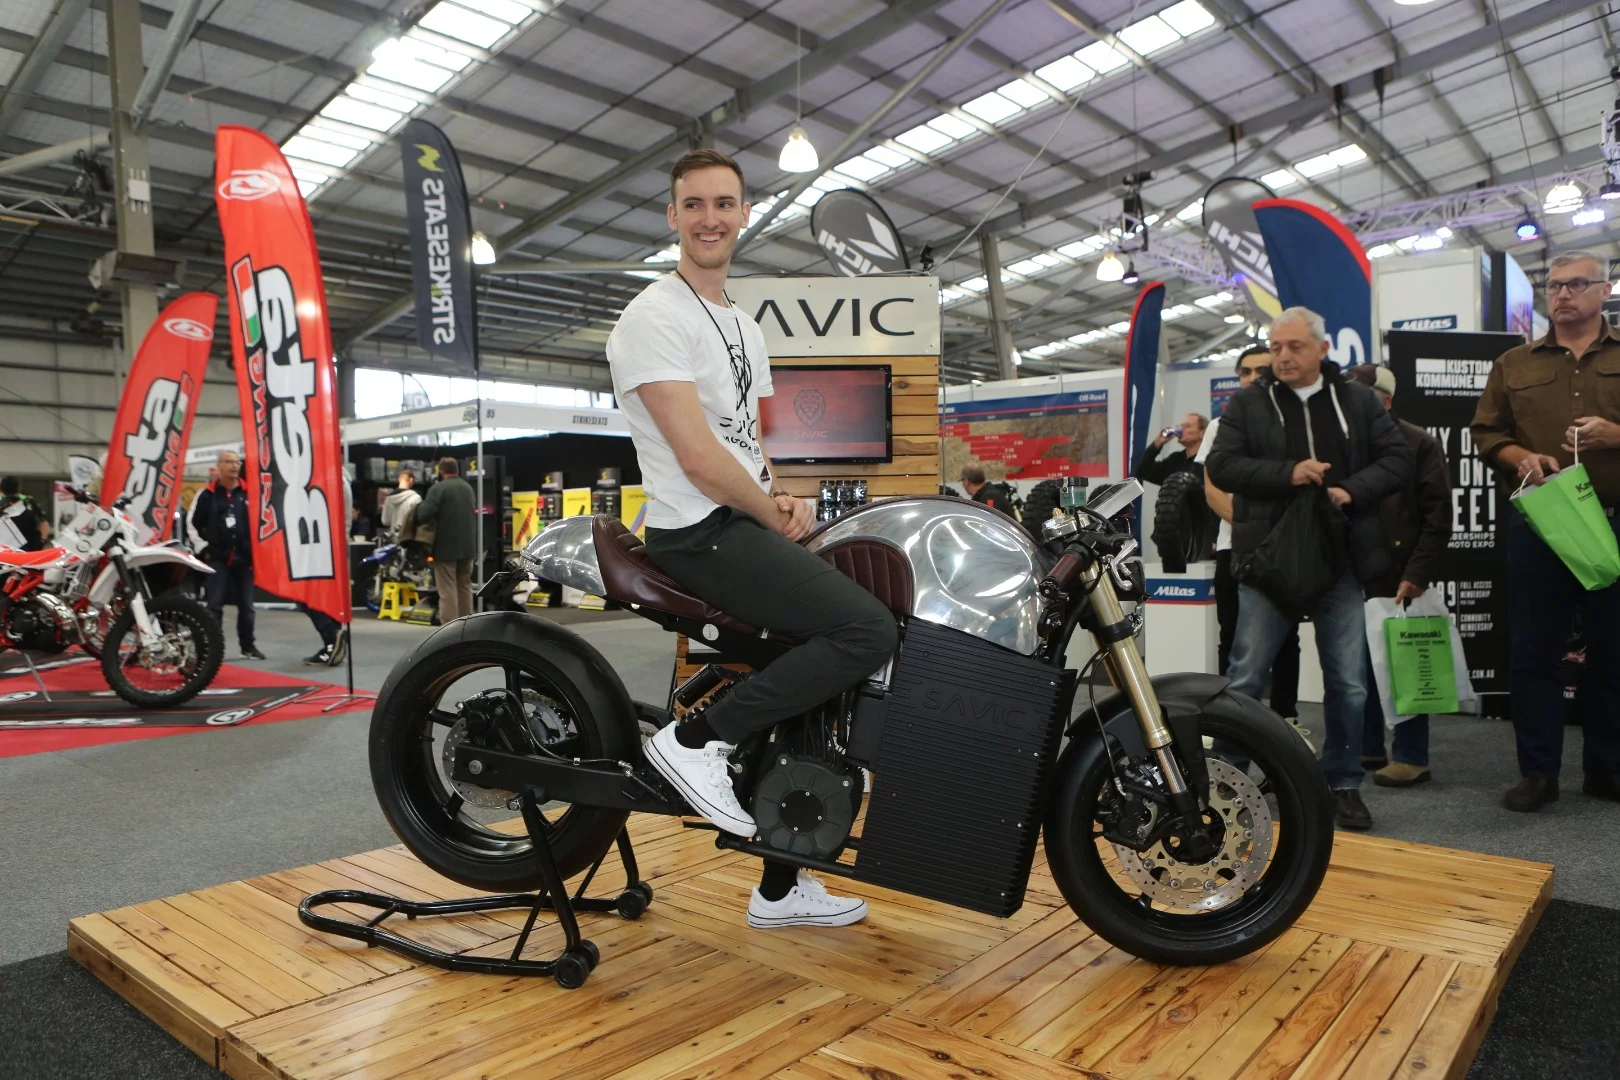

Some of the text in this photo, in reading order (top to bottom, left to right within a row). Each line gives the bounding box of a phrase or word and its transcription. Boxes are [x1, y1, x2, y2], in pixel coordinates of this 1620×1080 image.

[753, 297, 915, 338] AVIC
[1446, 359, 1493, 374] KUSTOM
[1415, 373, 1474, 389] KOMMUNE
[1449, 532, 1495, 541] BERSHIPS
[1153, 586, 1197, 597] Mitas
[922, 688, 1028, 730] SAVIC
